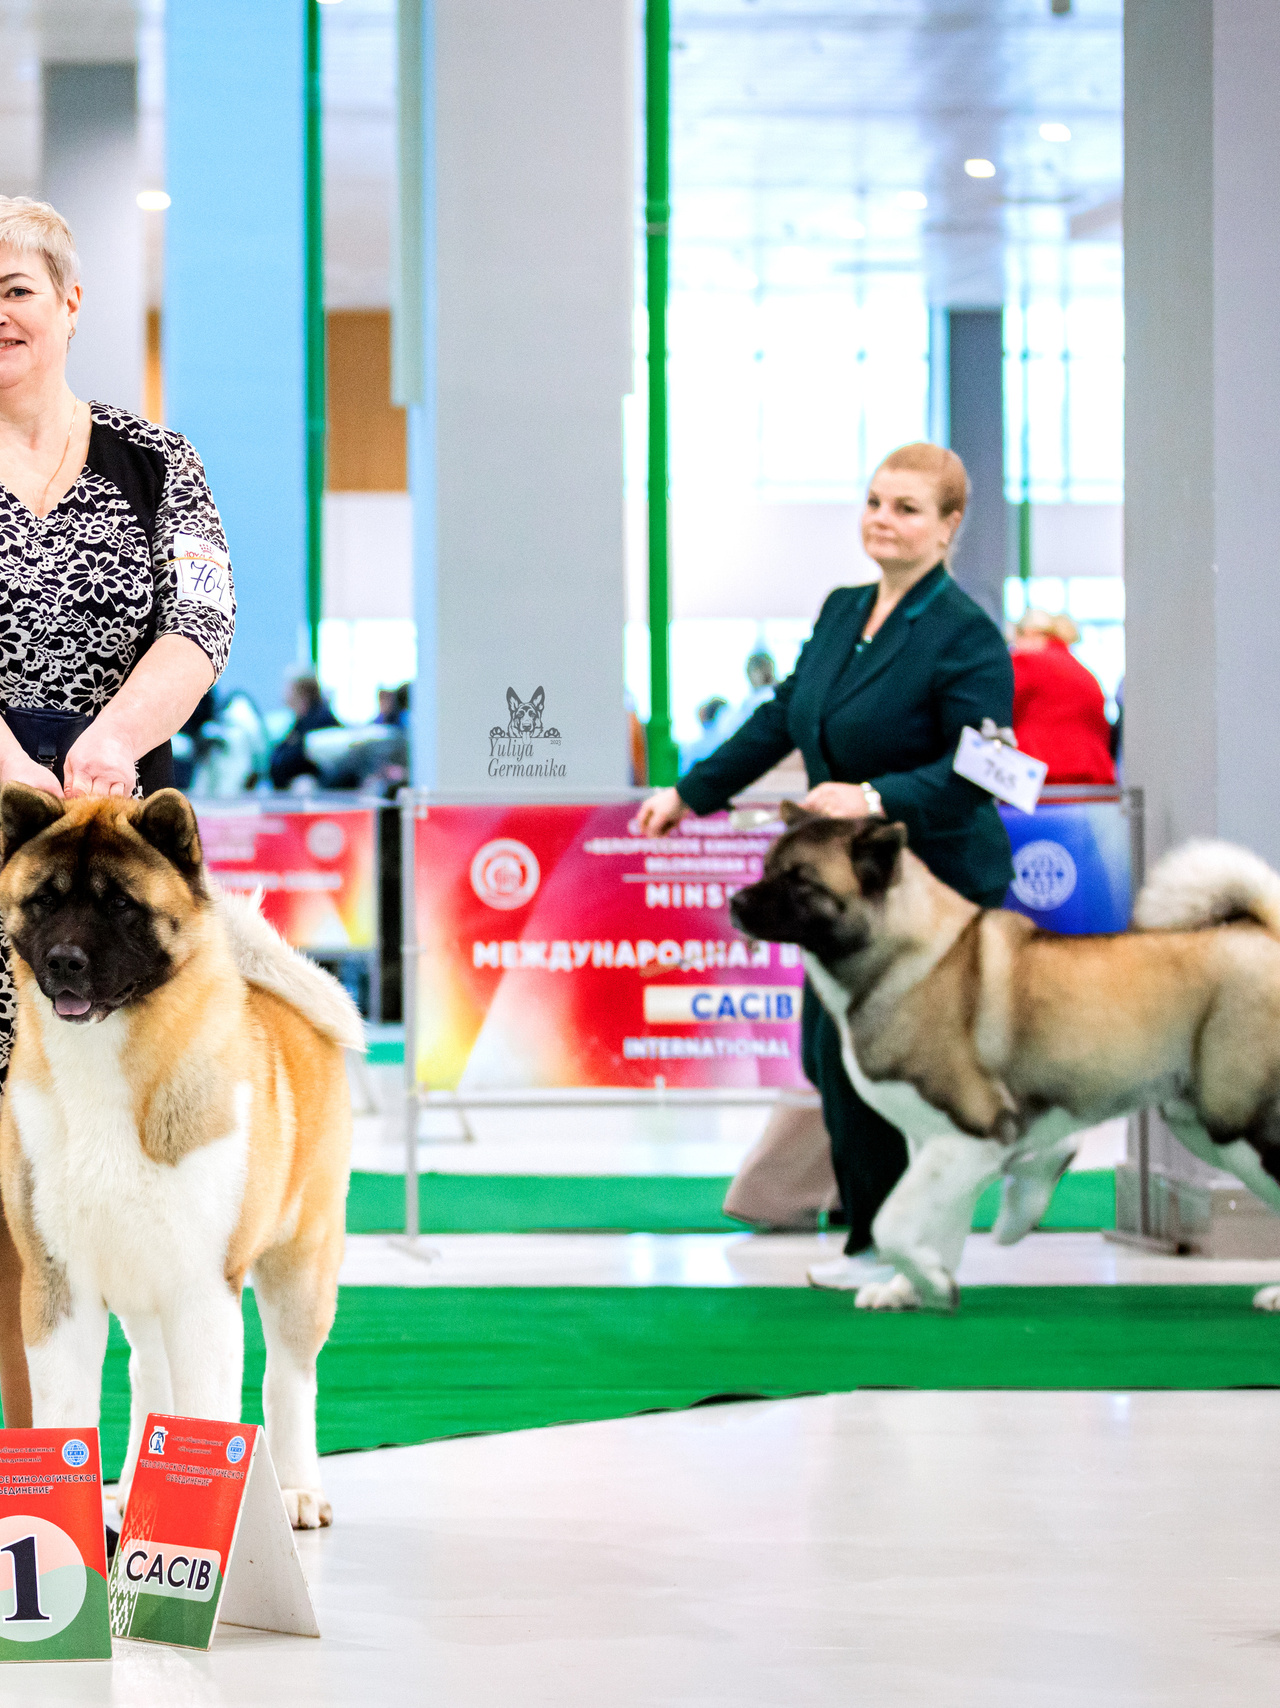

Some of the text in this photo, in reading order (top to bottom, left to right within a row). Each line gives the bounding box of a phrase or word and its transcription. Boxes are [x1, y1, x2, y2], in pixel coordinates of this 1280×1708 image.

[190, 561, 226, 602] 764
[645, 883, 734, 909] MINS
[472, 940, 771, 971] МЕЖДУНАРОДНАЯ
[691, 993, 793, 1020] CACIB
[623, 1036, 791, 1059] INTERNATIONAL
[12, 1474, 97, 1484] КИНОЛОГИЧЕСКОЕ
[0, 1534, 51, 1621] 1
[125, 1550, 212, 1592] CACIB
